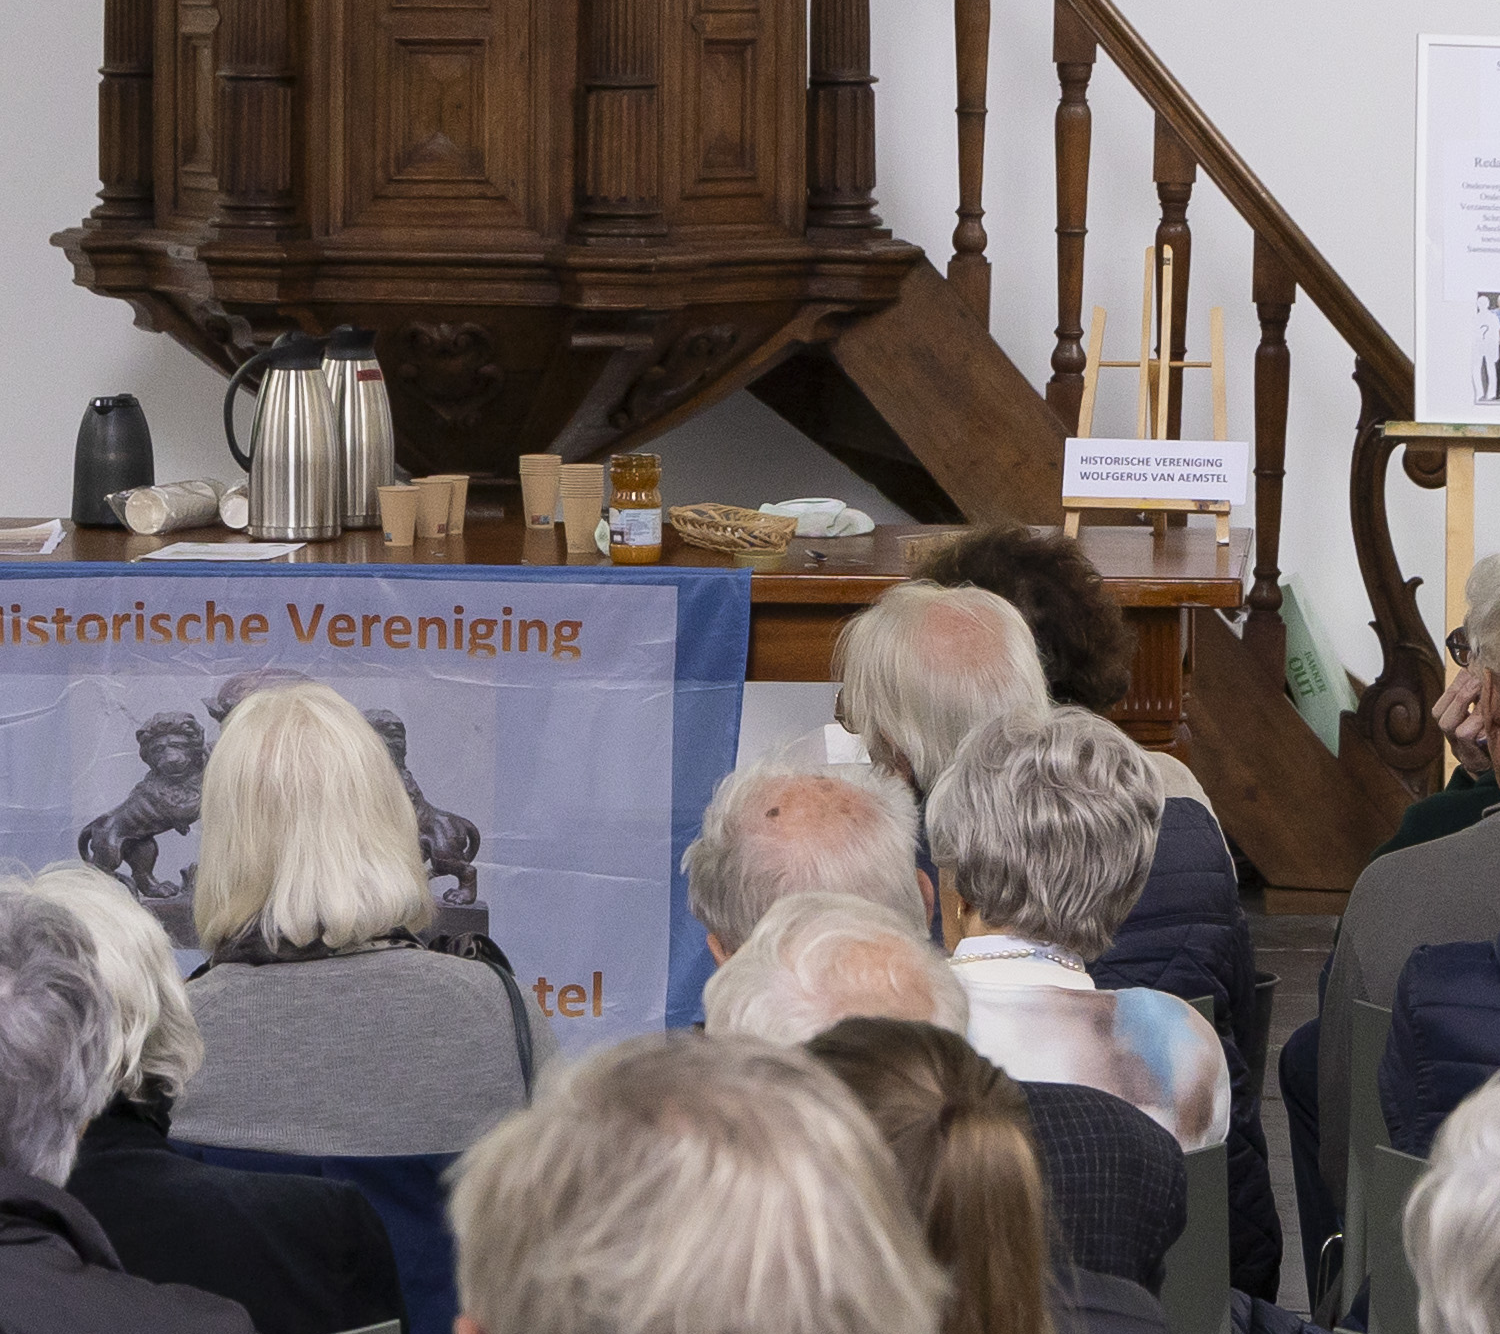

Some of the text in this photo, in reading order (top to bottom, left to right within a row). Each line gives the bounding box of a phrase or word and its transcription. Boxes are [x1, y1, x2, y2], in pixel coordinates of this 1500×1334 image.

[1080, 455, 1223, 468] HISTORISCHE VERENIGING
[1079, 471, 1228, 483] WOLFGERUS VAN AEMSTEL
[285, 603, 584, 661] Vereniging
